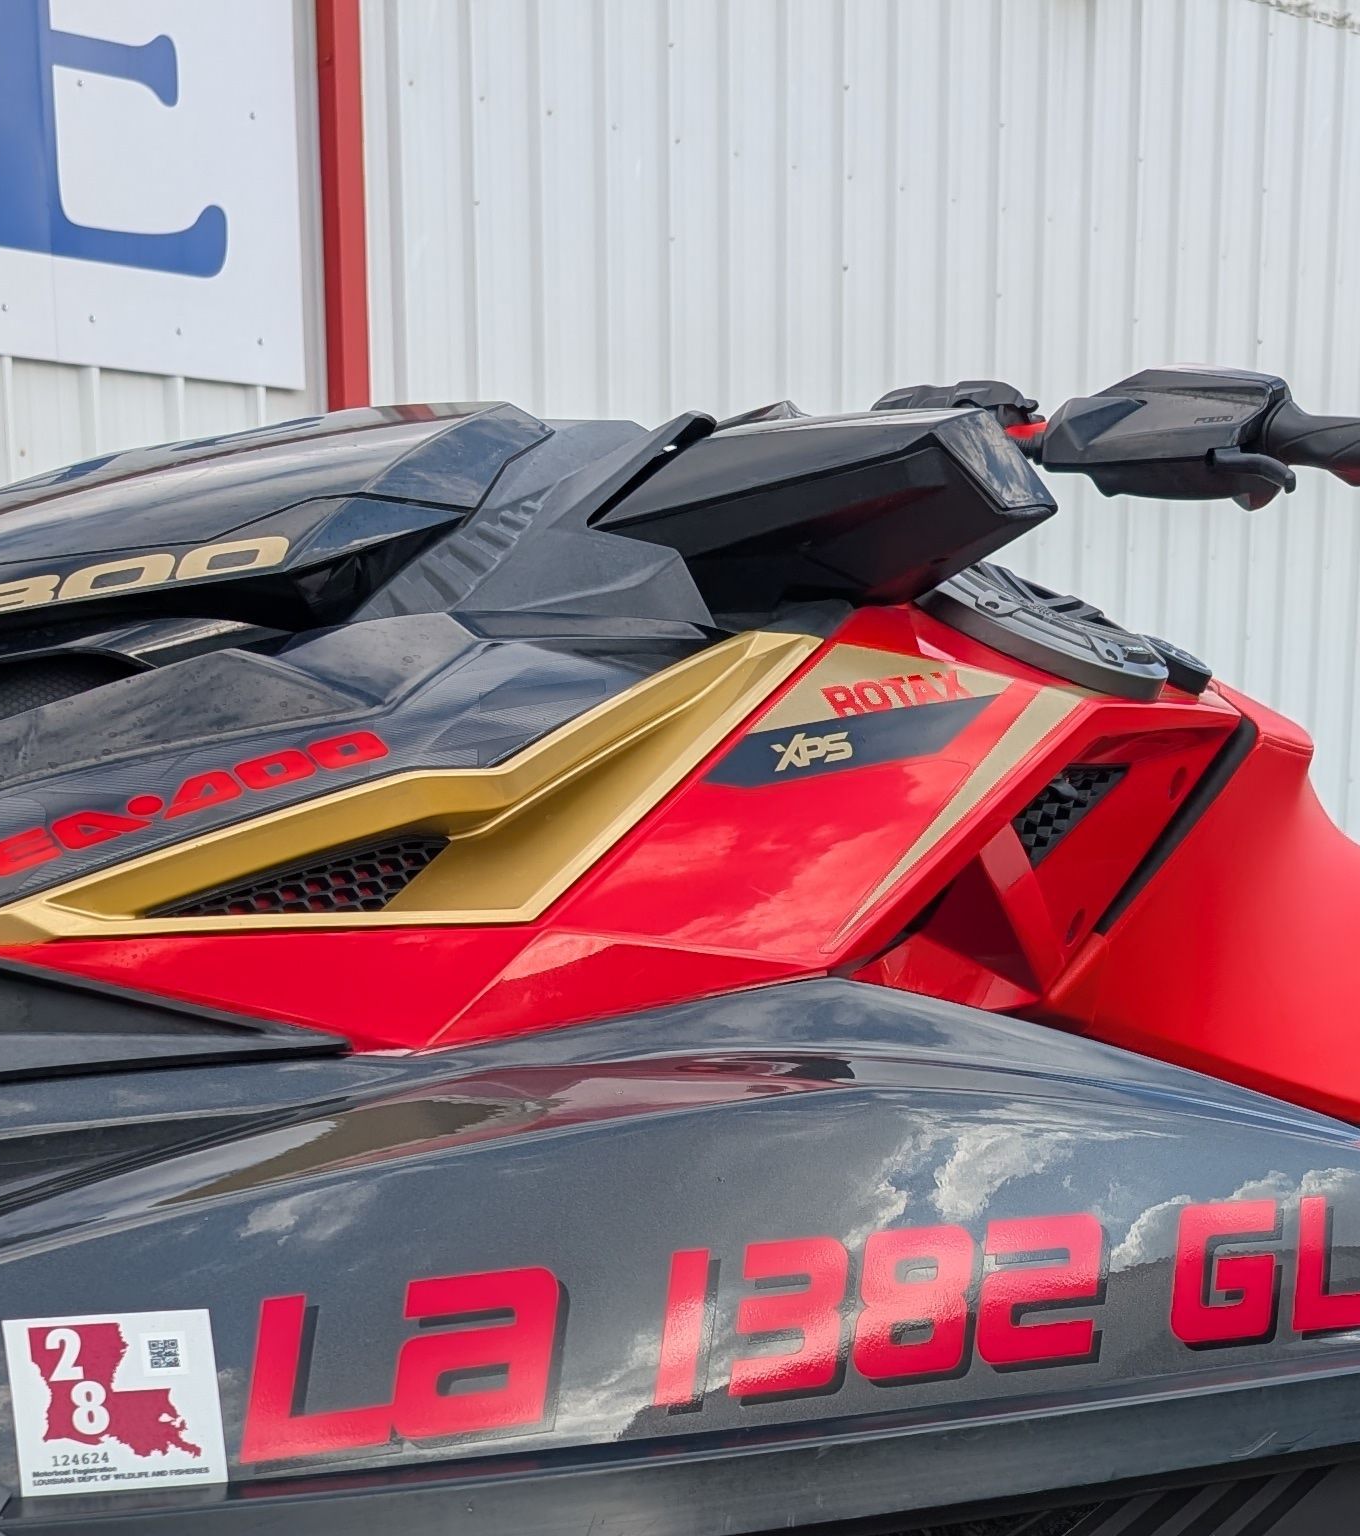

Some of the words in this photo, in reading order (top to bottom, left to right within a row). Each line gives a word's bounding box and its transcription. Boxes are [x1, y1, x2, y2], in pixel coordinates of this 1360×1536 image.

[820, 670, 973, 718] ROTAX
[770, 731, 853, 772] XPS
[653, 1213, 1108, 1410] 1382
[45, 1328, 85, 1382] 2
[71, 1380, 110, 1435] 8
[32, 1468, 71, 1478] Motorboat
[72, 1466, 118, 1476] Registration
[33, 1477, 75, 1487] LOUISIANA
[100, 1473, 112, 1481] OF
[151, 1469, 168, 1477] AND
[51, 1452, 110, 1467] 124624
